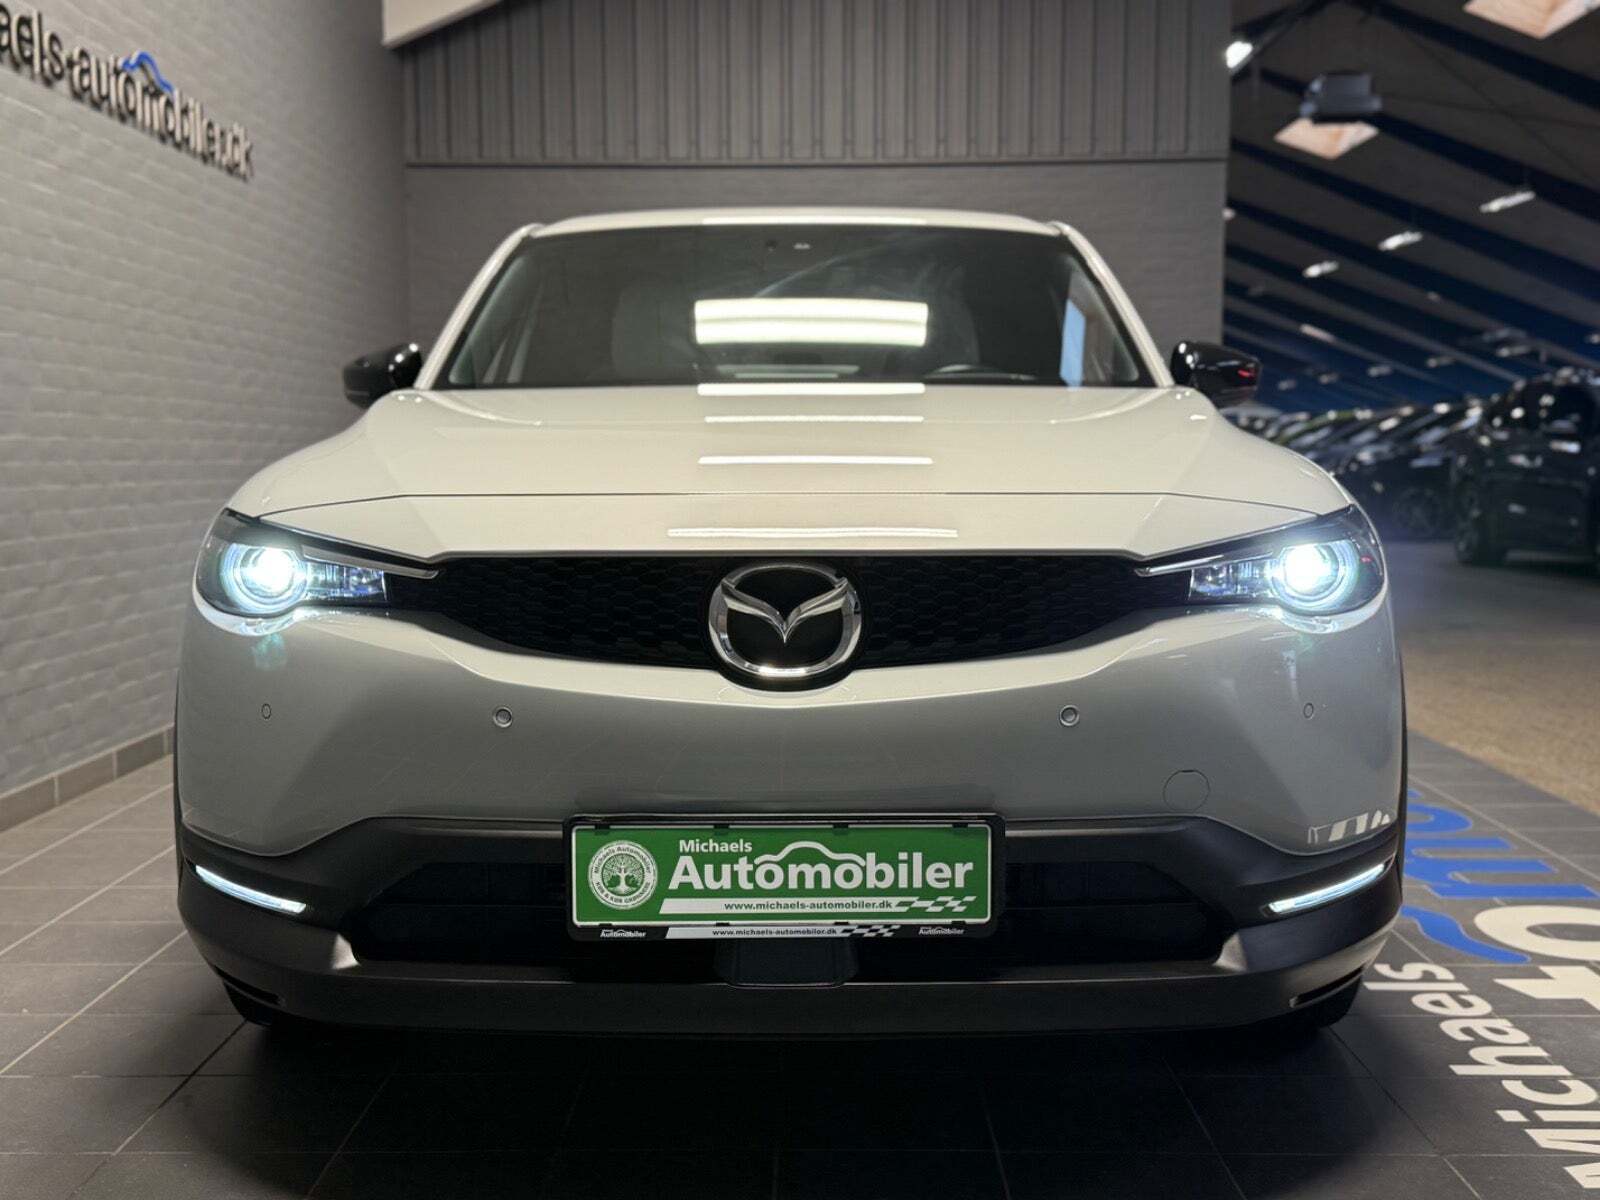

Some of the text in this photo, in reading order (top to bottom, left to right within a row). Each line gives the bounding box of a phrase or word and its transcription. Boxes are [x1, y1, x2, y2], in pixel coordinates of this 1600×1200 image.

[679, 838, 753, 853] Michaels
[668, 852, 973, 890] Automobiler
[724, 900, 893, 912] www.michaels-automobiler.dk
[712, 928, 837, 936] www.michaels-automobiler.dk
